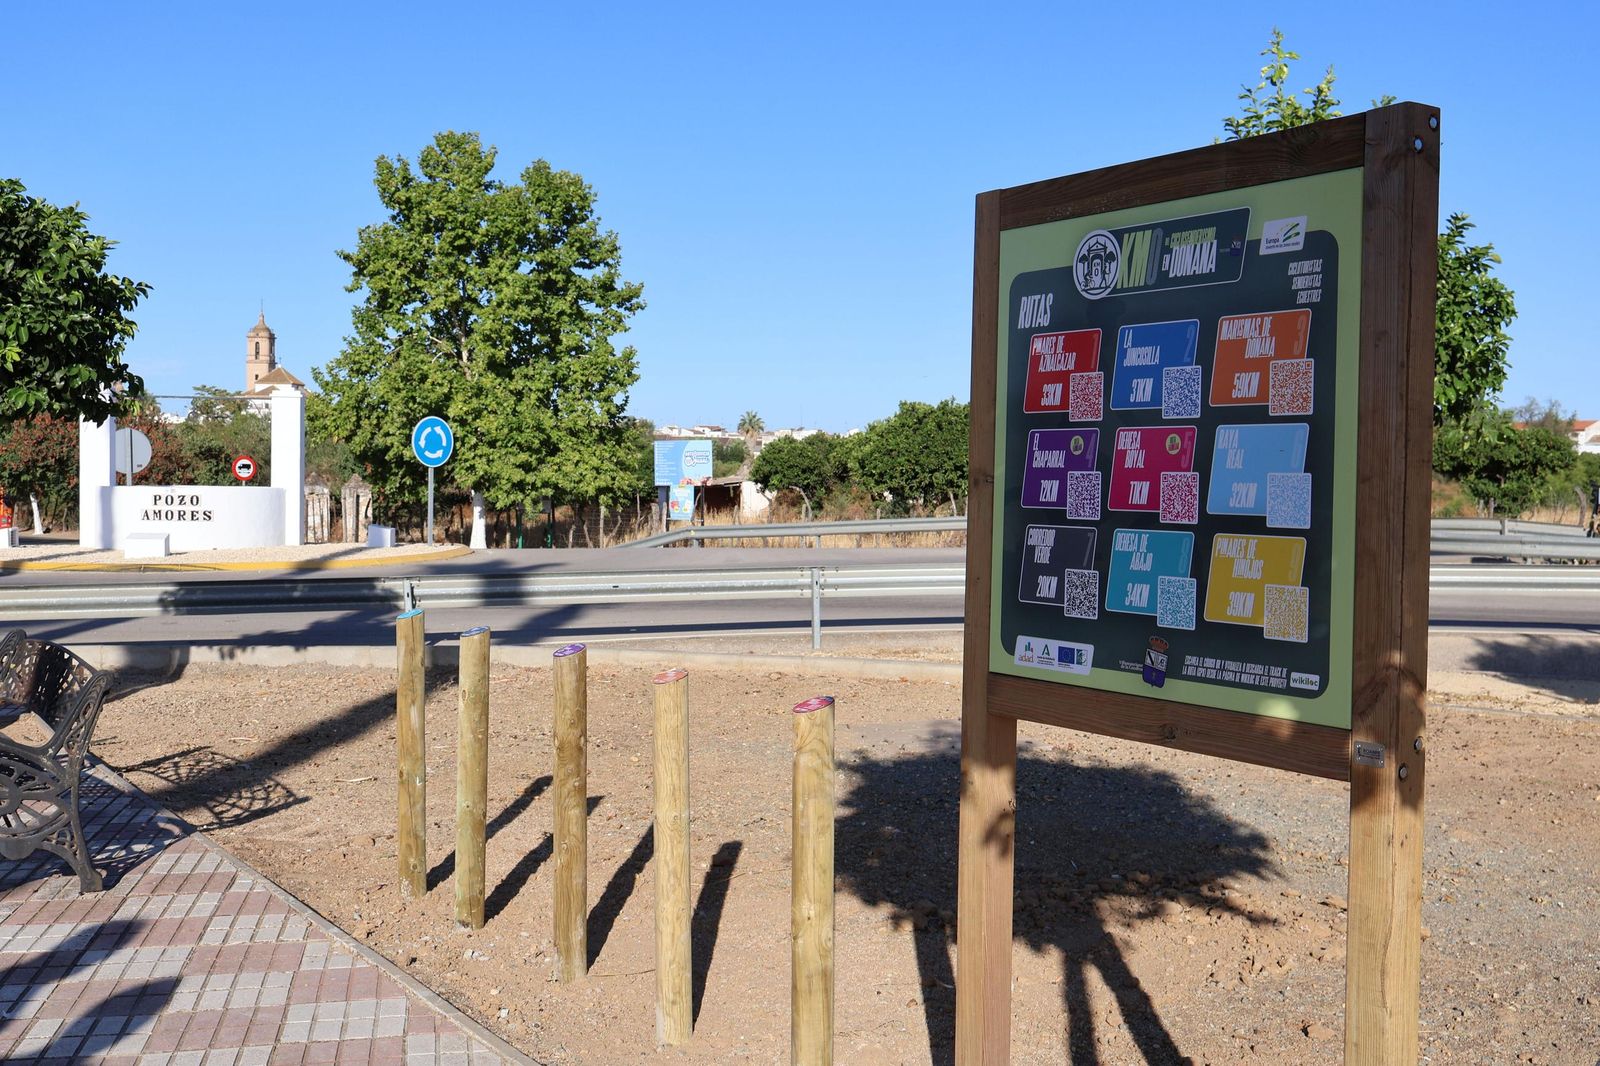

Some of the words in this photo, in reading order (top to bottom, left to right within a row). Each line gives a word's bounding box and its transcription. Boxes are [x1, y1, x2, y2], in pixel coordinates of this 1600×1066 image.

[1162, 254, 1170, 271] EN
[1018, 293, 1053, 329] RUTAS
[1220, 318, 1260, 340] MARISMAS
[1262, 316, 1272, 336] DE
[1056, 336, 1065, 353] DE
[1124, 329, 1132, 348] LA
[1033, 433, 1040, 450] EL
[1118, 431, 1141, 450] DEHESA
[1218, 429, 1238, 449] RAYA
[1032, 450, 1066, 468] CHAPARRAL
[1124, 450, 1145, 468] BOYAL
[1226, 449, 1244, 469] REAL
[153, 494, 200, 506] POZO
[142, 510, 212, 521] AMORES
[1115, 532, 1138, 552] DEHESA
[1139, 534, 1149, 552] DE
[1247, 538, 1258, 559] DE
[1130, 552, 1153, 571] ABAJO
[1125, 583, 1150, 608] 34KM
[1292, 676, 1318, 686] wikiloc
